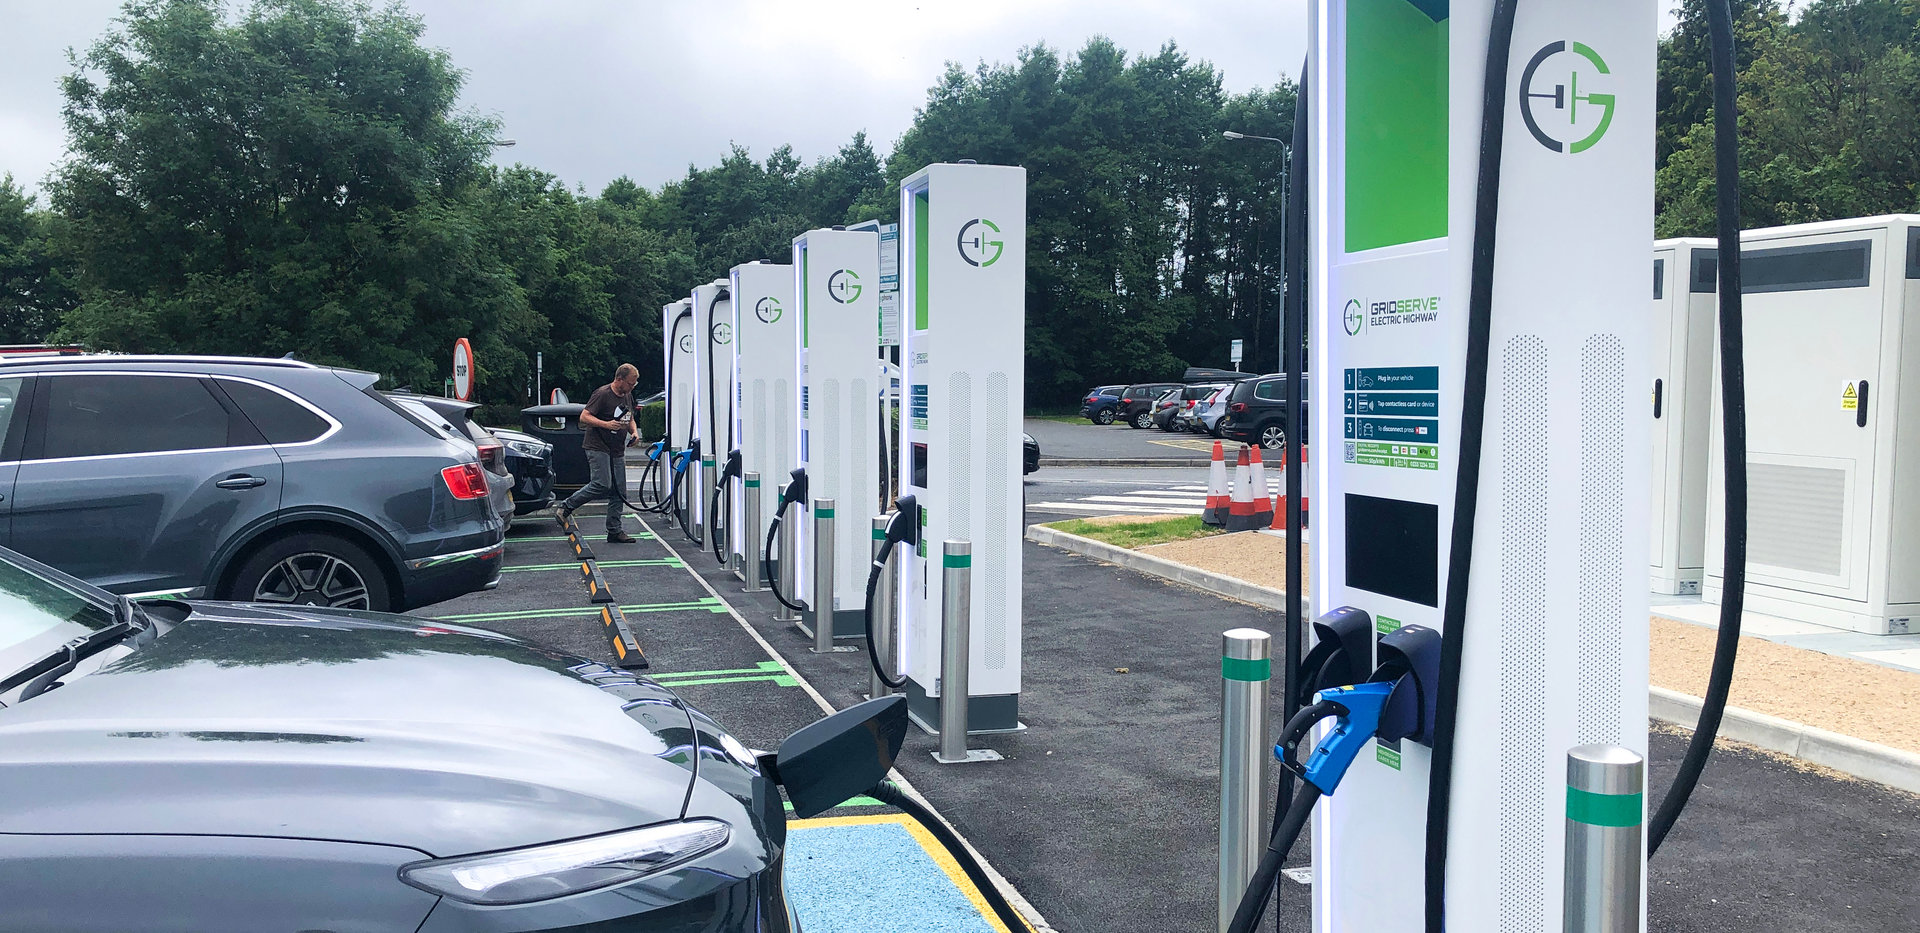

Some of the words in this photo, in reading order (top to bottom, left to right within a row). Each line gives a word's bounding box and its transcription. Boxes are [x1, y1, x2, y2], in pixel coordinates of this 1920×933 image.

[1371, 297, 1437, 315] GRIDSERVE
[1371, 315, 1401, 326] ELECTRIC
[1402, 312, 1438, 322] HIGHWAY
[456, 365, 466, 376] STOP
[1347, 374, 1351, 384] 1
[1348, 398, 1352, 409] 2
[1348, 422, 1352, 432] 3
[1383, 425, 1404, 433] disconnect
